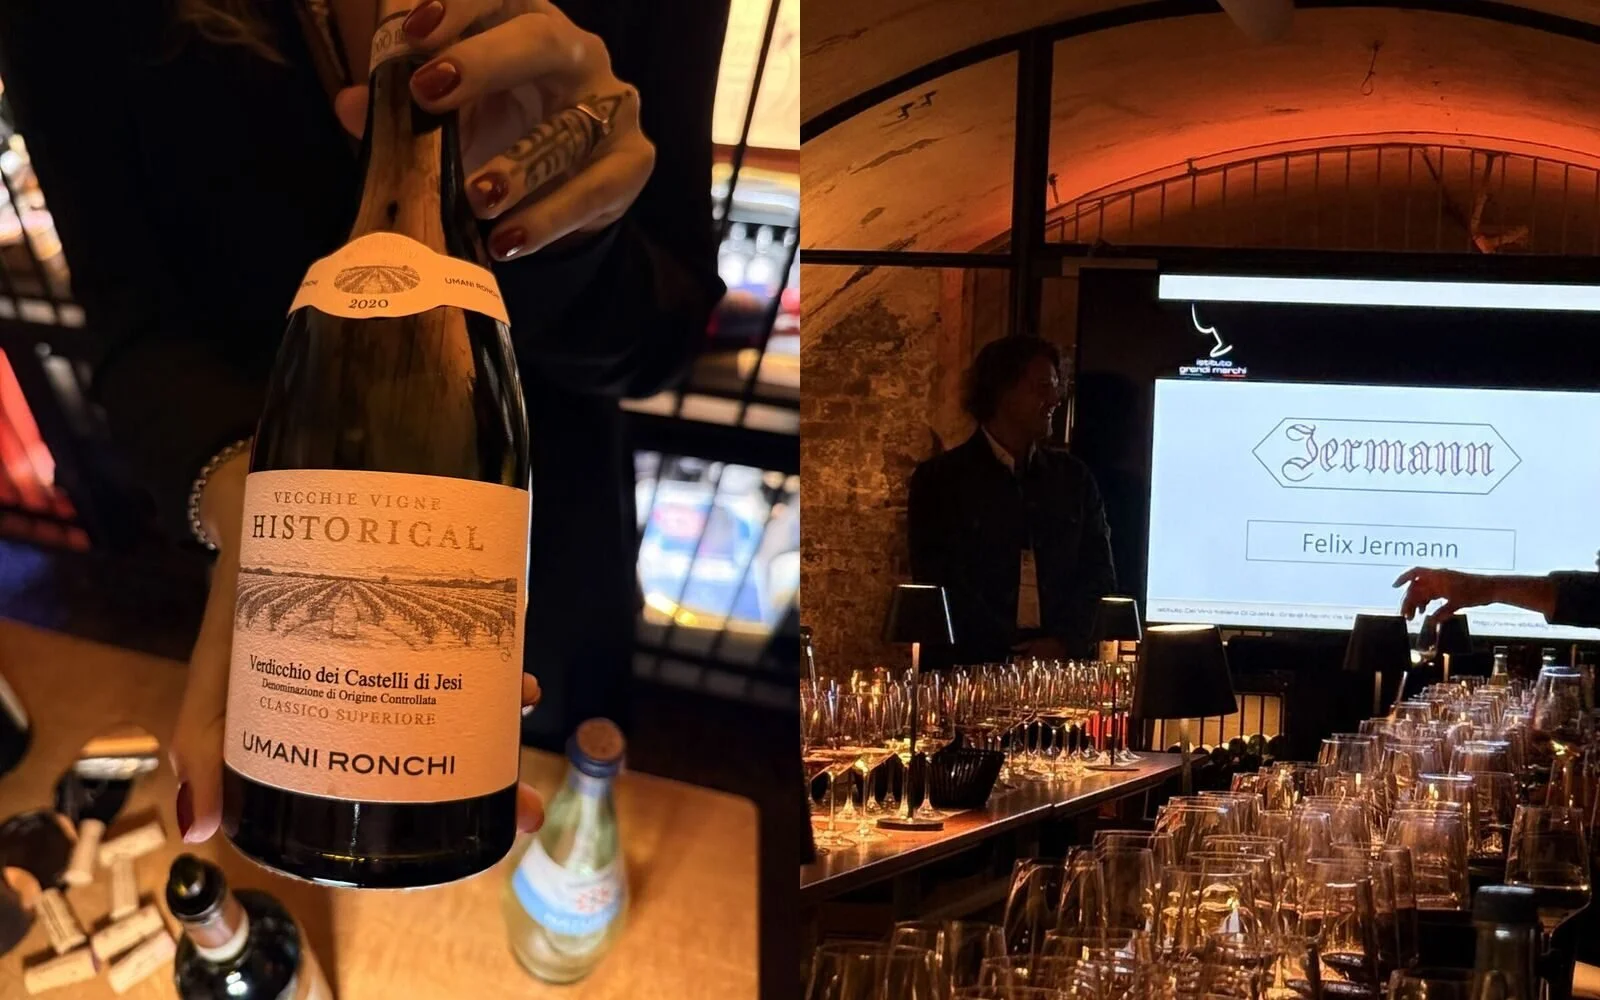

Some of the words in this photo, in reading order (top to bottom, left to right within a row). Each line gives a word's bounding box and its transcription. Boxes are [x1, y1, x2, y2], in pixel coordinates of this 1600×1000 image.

[444, 277, 475, 288] UMANI
[348, 298, 389, 309] 2020
[1179, 366, 1211, 375] grandi
[1212, 366, 1247, 374] marchi
[1196, 358, 1232, 367] istituto
[1281, 423, 1495, 482] Jermann
[274, 491, 358, 506] VECCHIE
[370, 493, 442, 511] VIGNE
[252, 514, 484, 551] HISTORICAL
[1303, 533, 1353, 554] Felix
[1360, 535, 1459, 558] Jermann
[249, 654, 311, 681] Verdicchio
[315, 666, 339, 684] dei
[345, 669, 408, 689] Castelli
[414, 673, 429, 690] di
[434, 673, 463, 690] Jesi
[262, 678, 324, 698] Denominazione
[326, 687, 336, 699] di
[338, 689, 377, 705] Origine
[380, 692, 437, 706] Controllata
[259, 696, 329, 719] CLASSICO
[336, 708, 436, 725] SUPERIORE
[241, 730, 318, 768] UMANI
[328, 751, 456, 776] RONCHI
